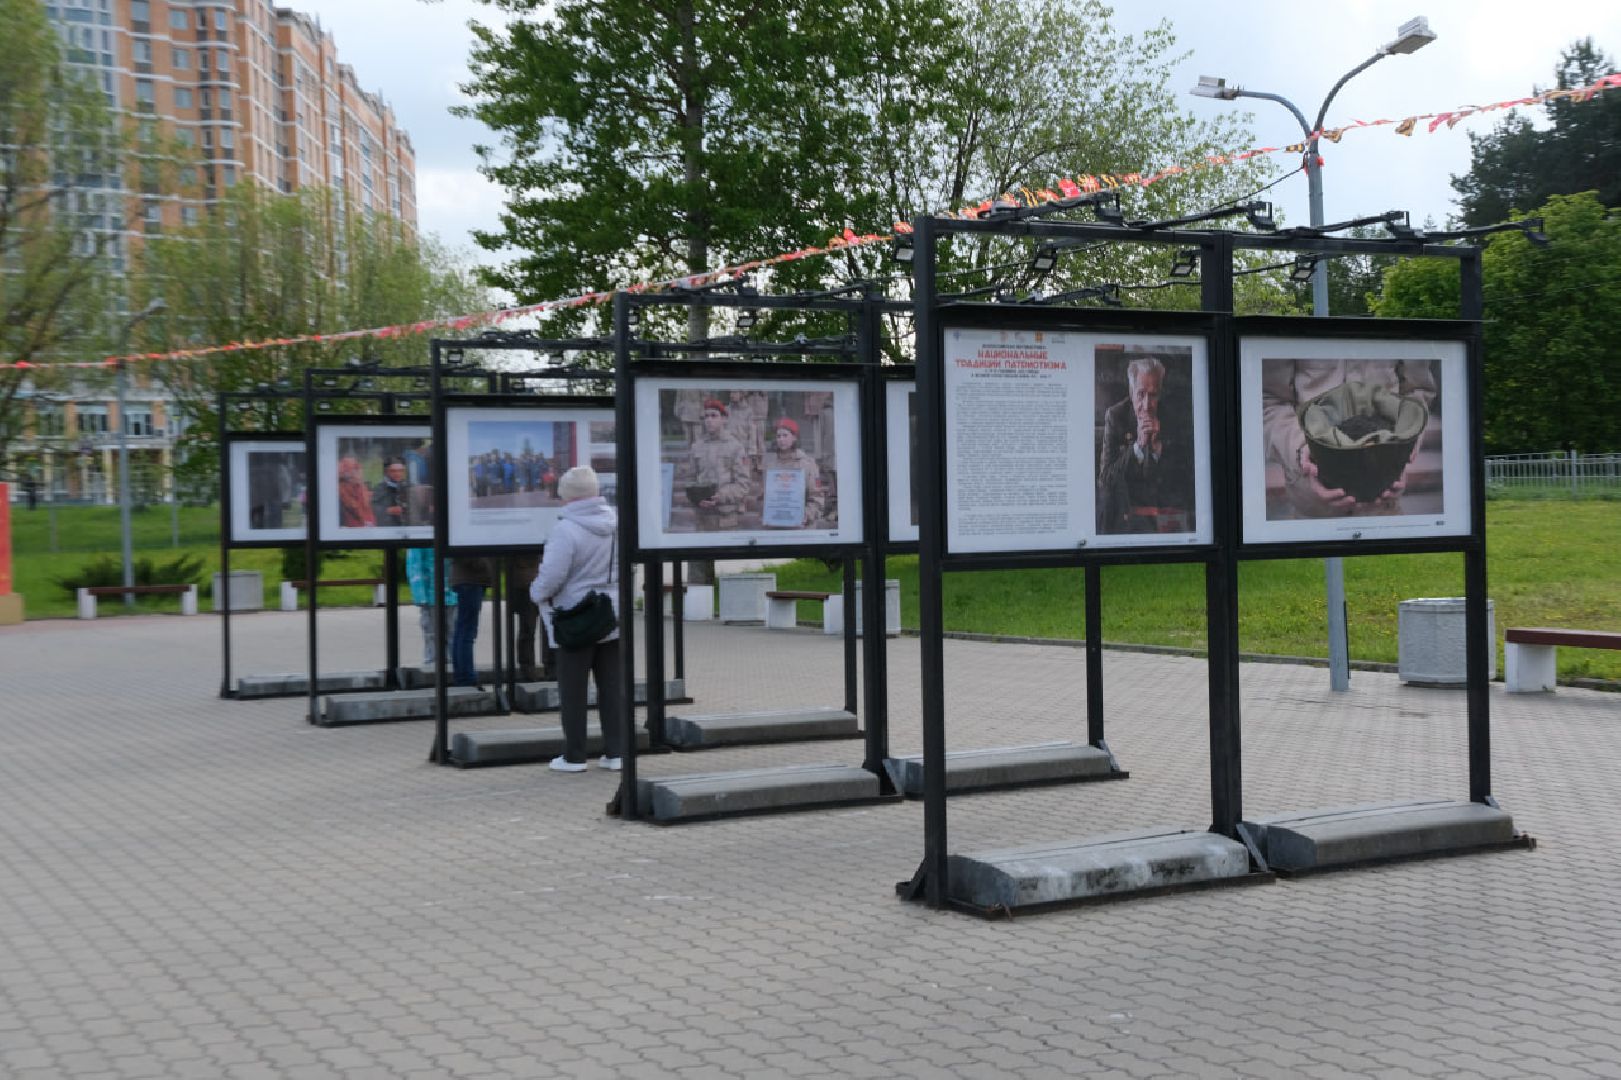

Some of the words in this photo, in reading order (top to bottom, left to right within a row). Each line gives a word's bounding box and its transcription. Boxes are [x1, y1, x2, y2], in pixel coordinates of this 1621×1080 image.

[978, 349, 1048, 359] НАЦИОНАЛЬНЫЕ
[955, 359, 1001, 368] ТРАДИЦИИ
[1005, 360, 1067, 369] ПАТРИОТИЗМА
